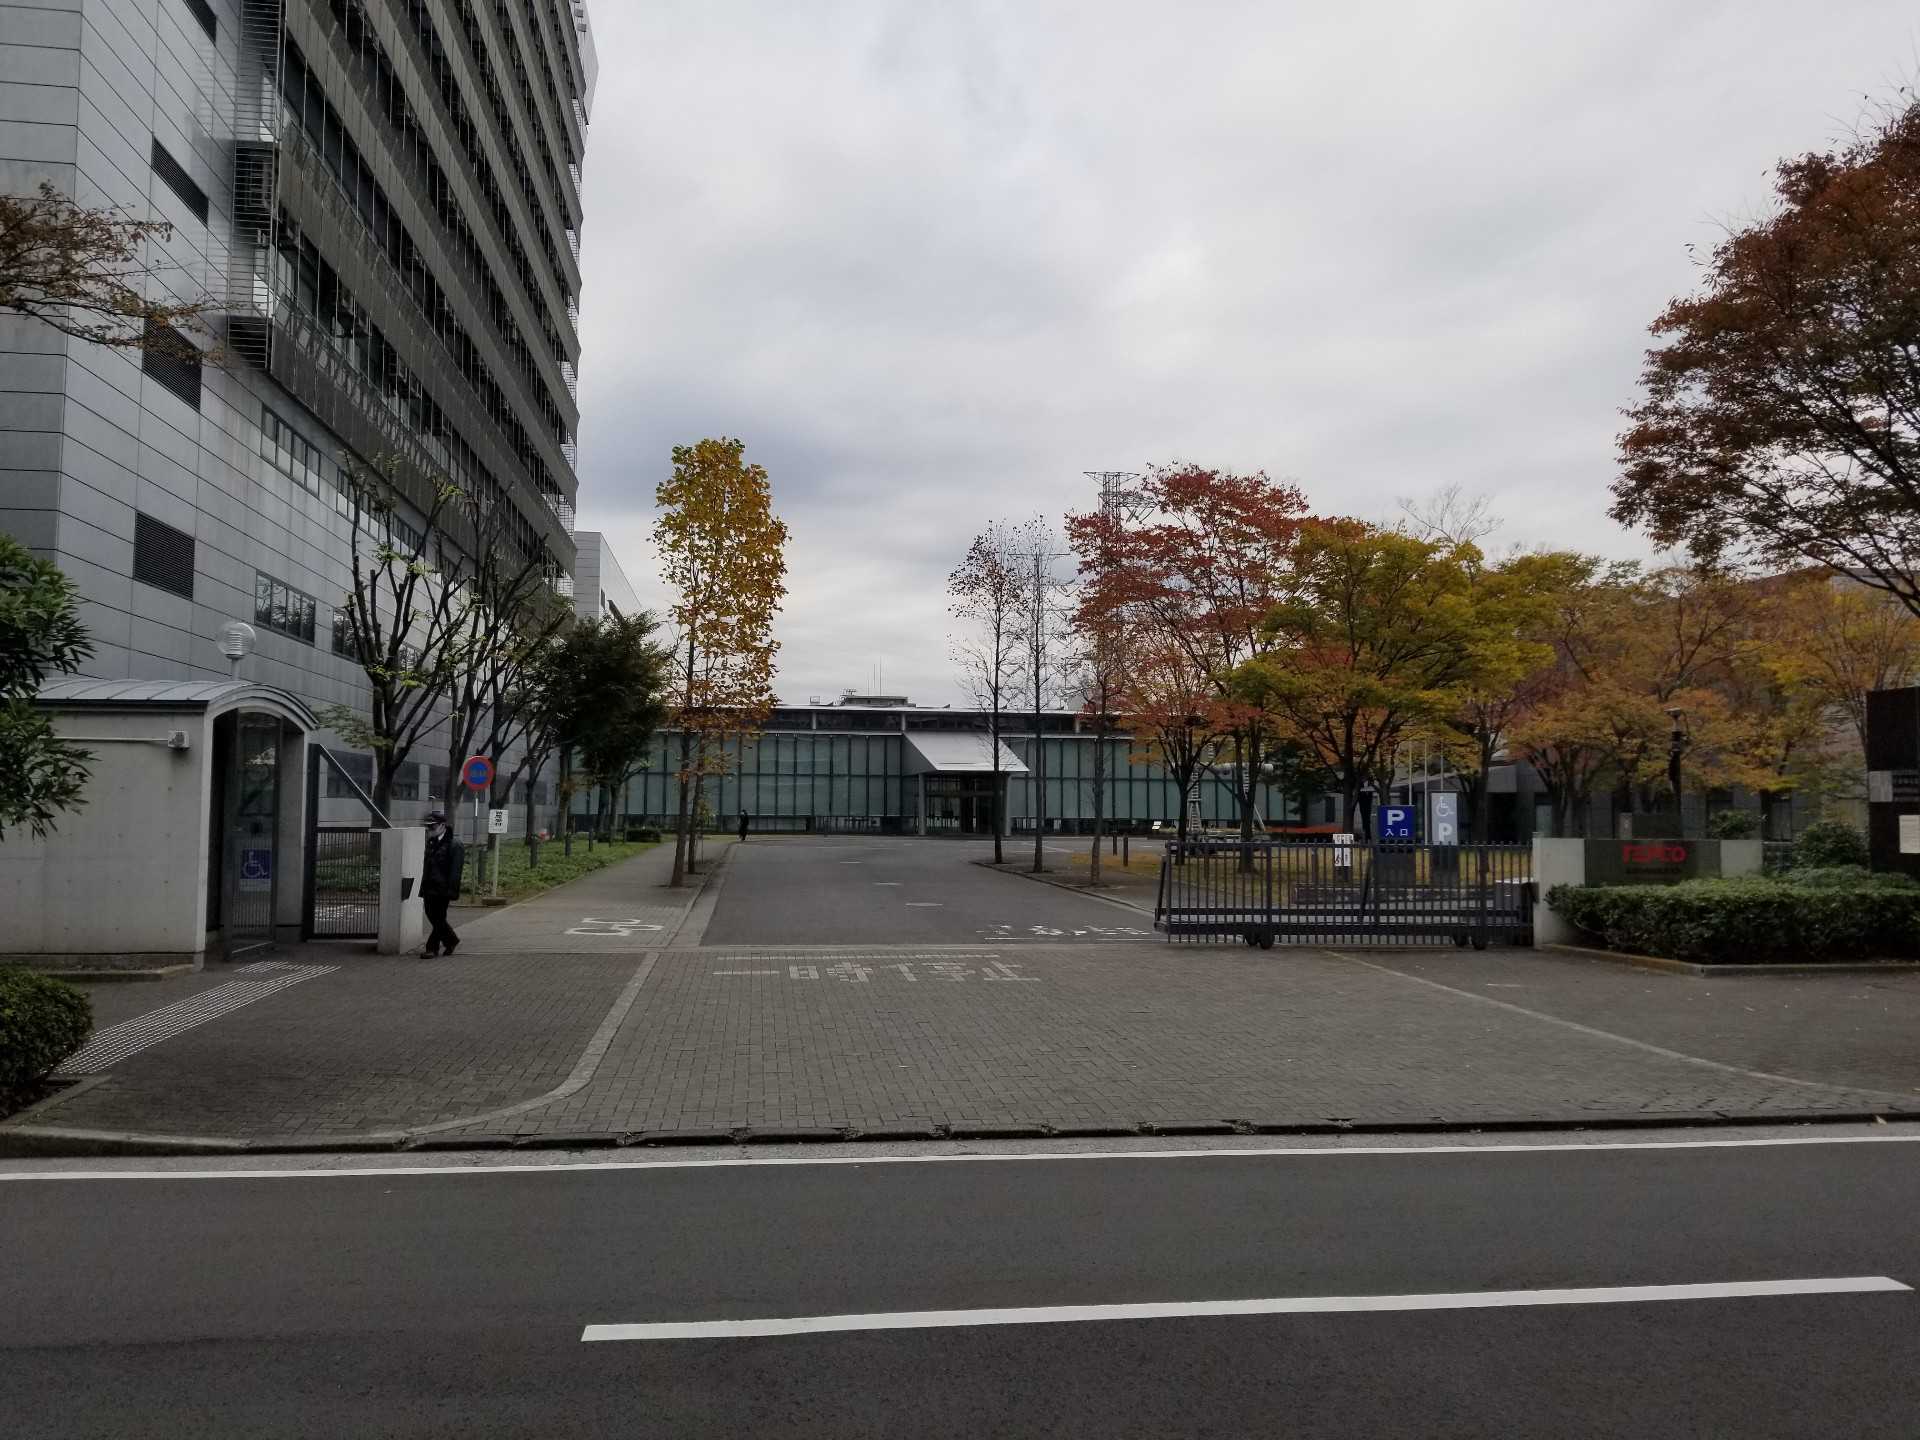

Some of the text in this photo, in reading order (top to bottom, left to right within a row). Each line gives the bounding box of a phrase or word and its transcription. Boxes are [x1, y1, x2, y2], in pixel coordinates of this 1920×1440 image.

[1387, 809, 1405, 826] P
[1385, 828, 1408, 837] 入口
[1439, 823, 1453, 842] P
